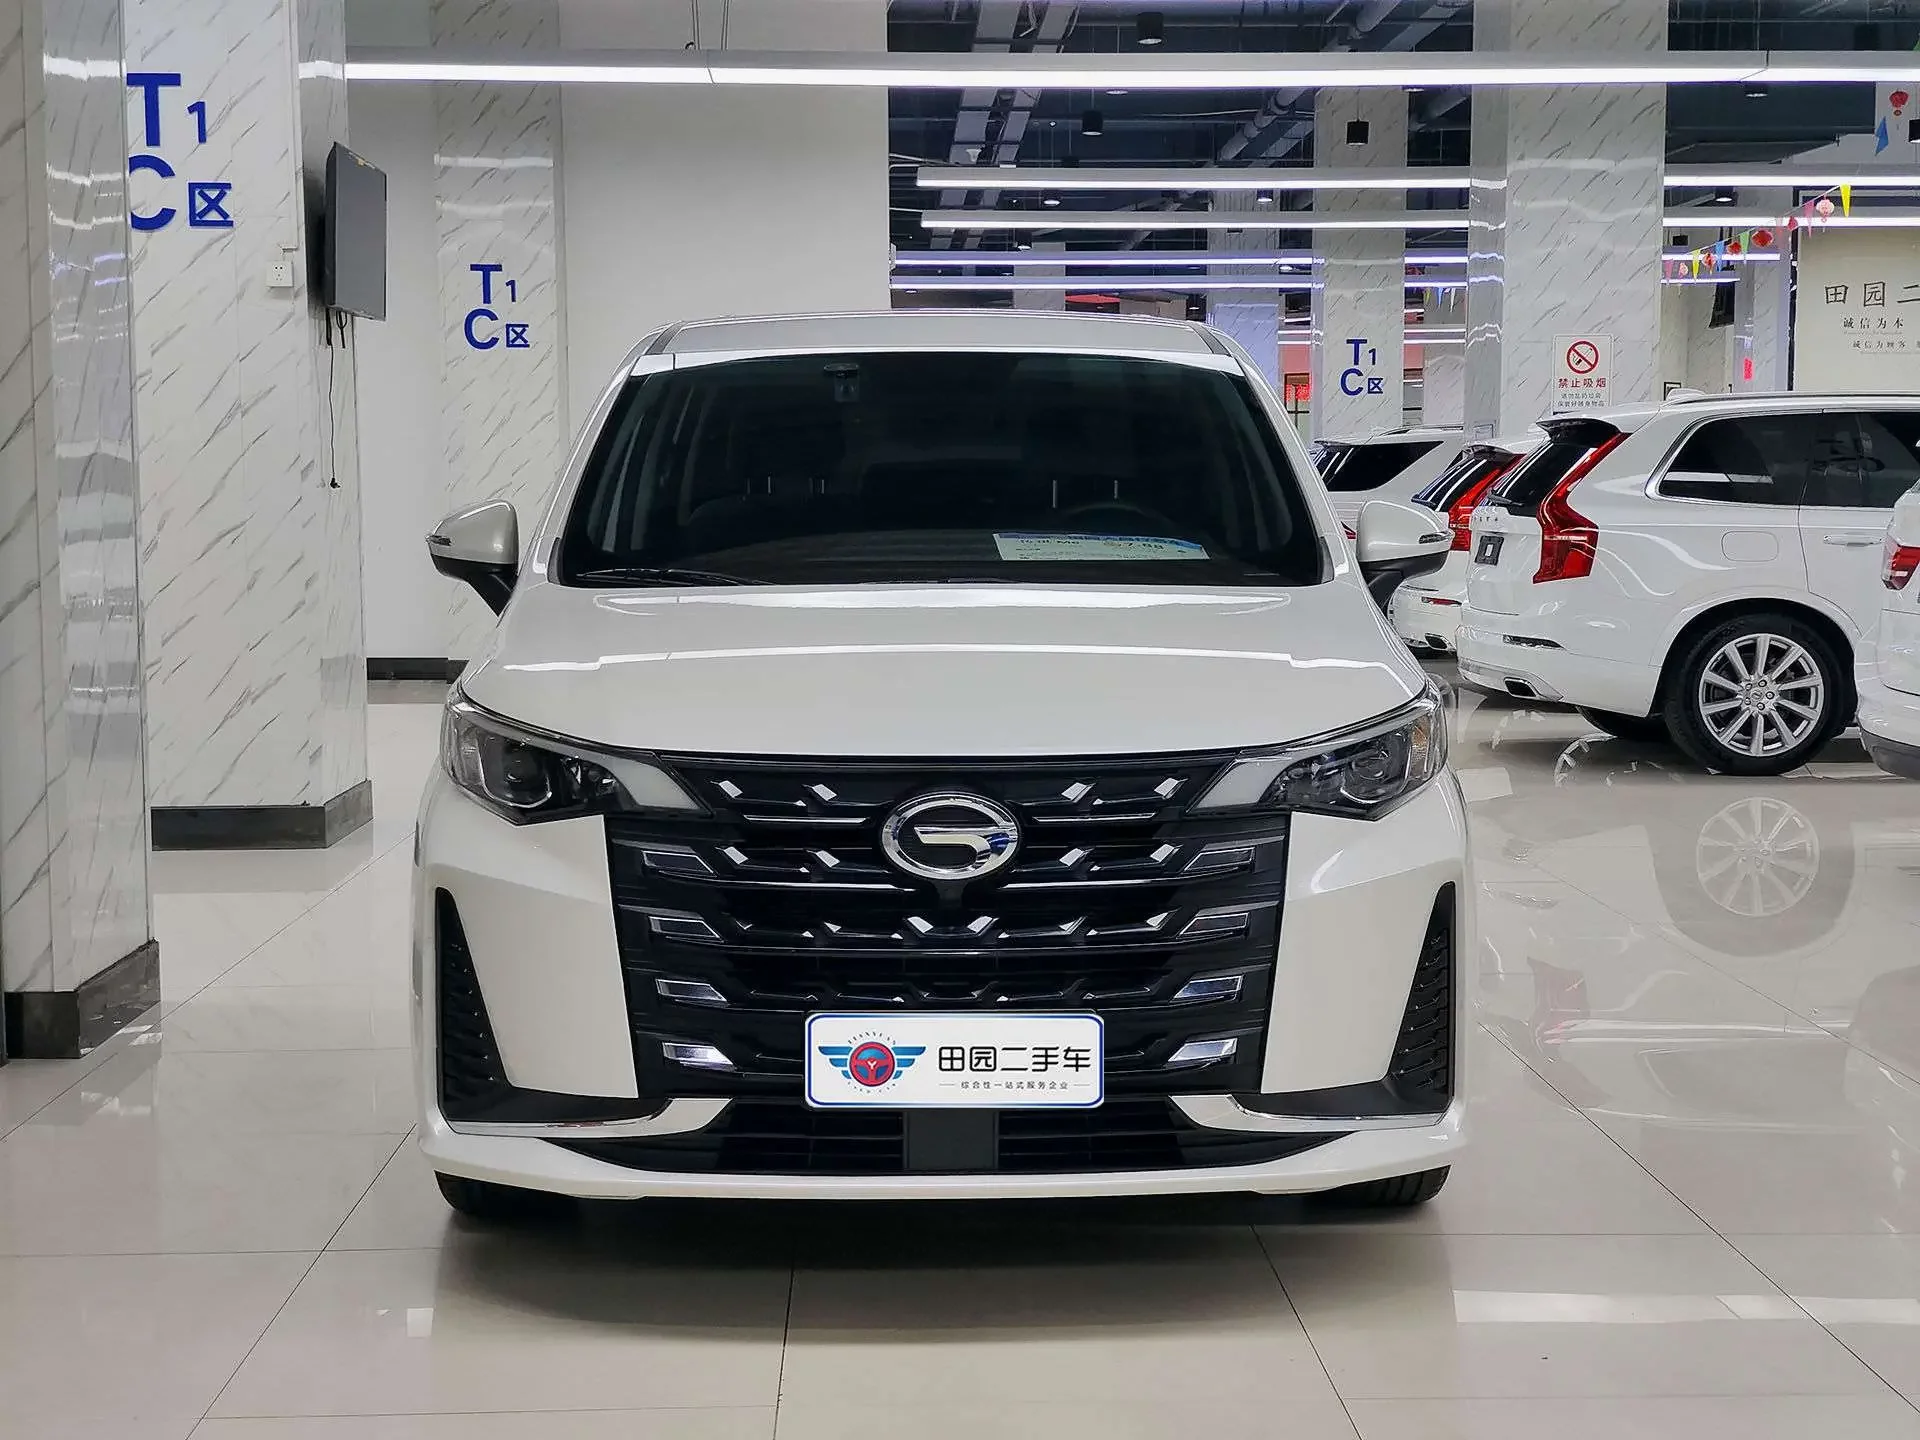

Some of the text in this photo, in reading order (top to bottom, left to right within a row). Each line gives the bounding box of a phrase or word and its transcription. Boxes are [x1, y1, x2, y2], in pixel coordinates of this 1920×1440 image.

[464, 308, 530, 350] C区
[1340, 368, 1384, 396] C区
[1558, 377, 1607, 389] 禁止吸烟
[938, 1046, 1092, 1072] 田园二手车
[960, 1081, 1069, 1090] 综合性一站式服务企业
